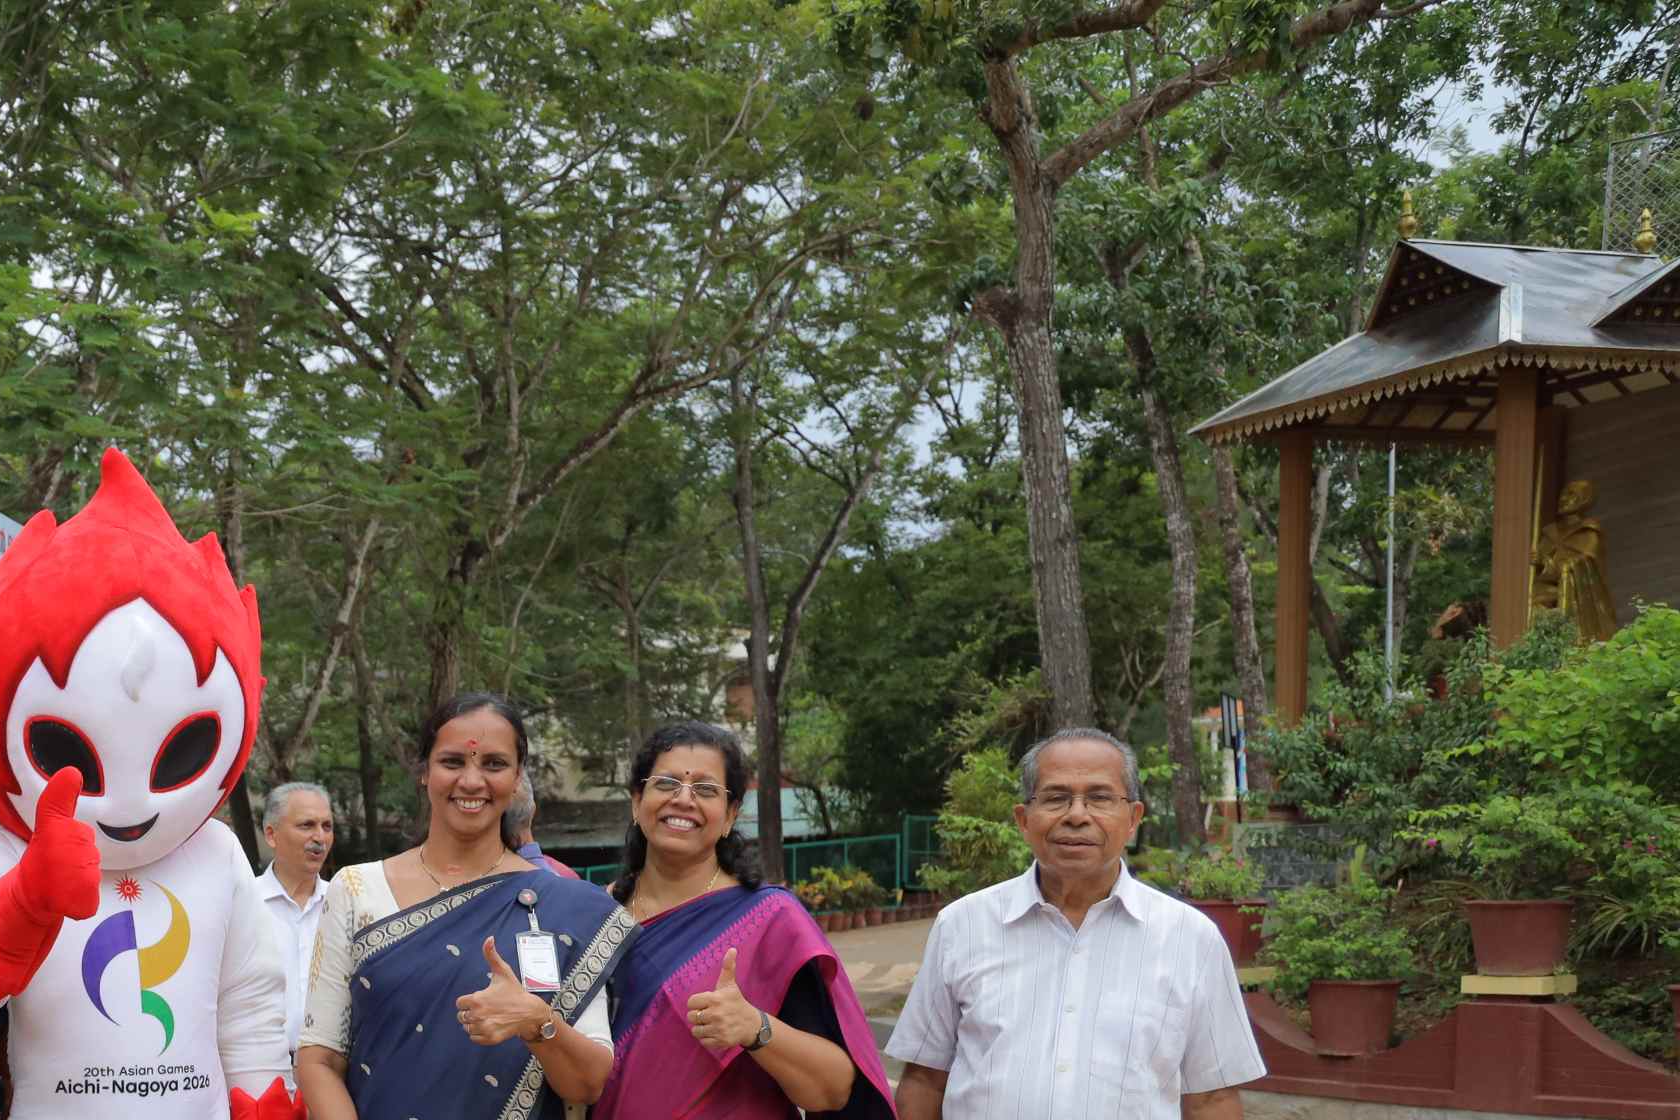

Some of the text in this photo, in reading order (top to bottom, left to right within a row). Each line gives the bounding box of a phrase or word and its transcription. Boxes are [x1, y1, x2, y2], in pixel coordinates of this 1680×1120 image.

[83, 1063, 195, 1078] 20th Asian Games
[55, 1075, 210, 1097] Aichi-Nagoya 2026
